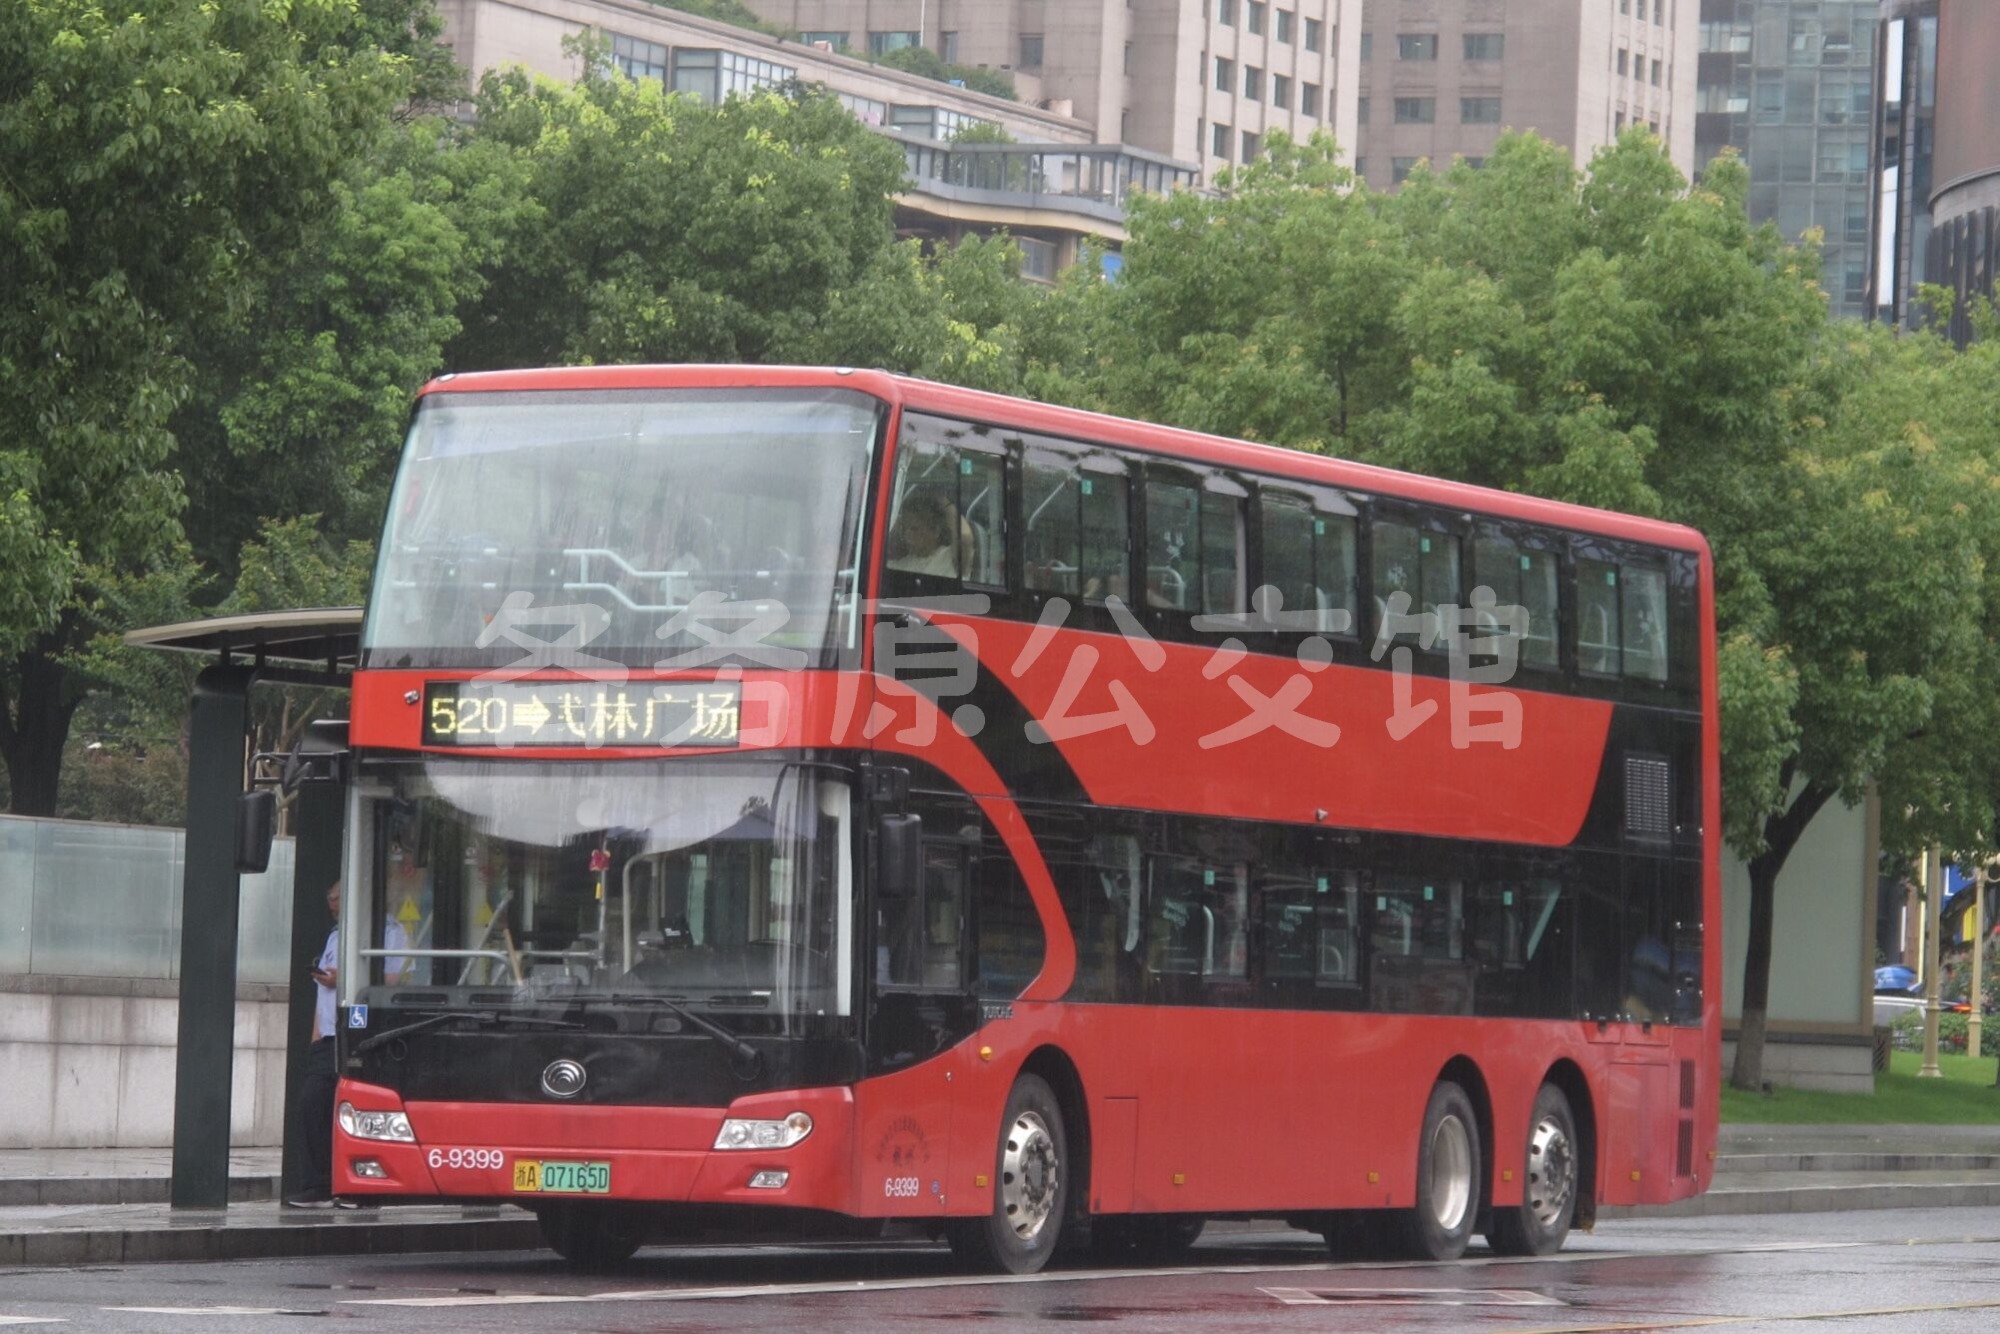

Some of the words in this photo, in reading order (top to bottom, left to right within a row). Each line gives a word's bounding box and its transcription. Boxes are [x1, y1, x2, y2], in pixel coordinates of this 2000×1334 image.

[432, 697, 507, 734] 520
[428, 1148, 504, 1169] 6-9399
[885, 1177, 920, 1197] 6-9399
